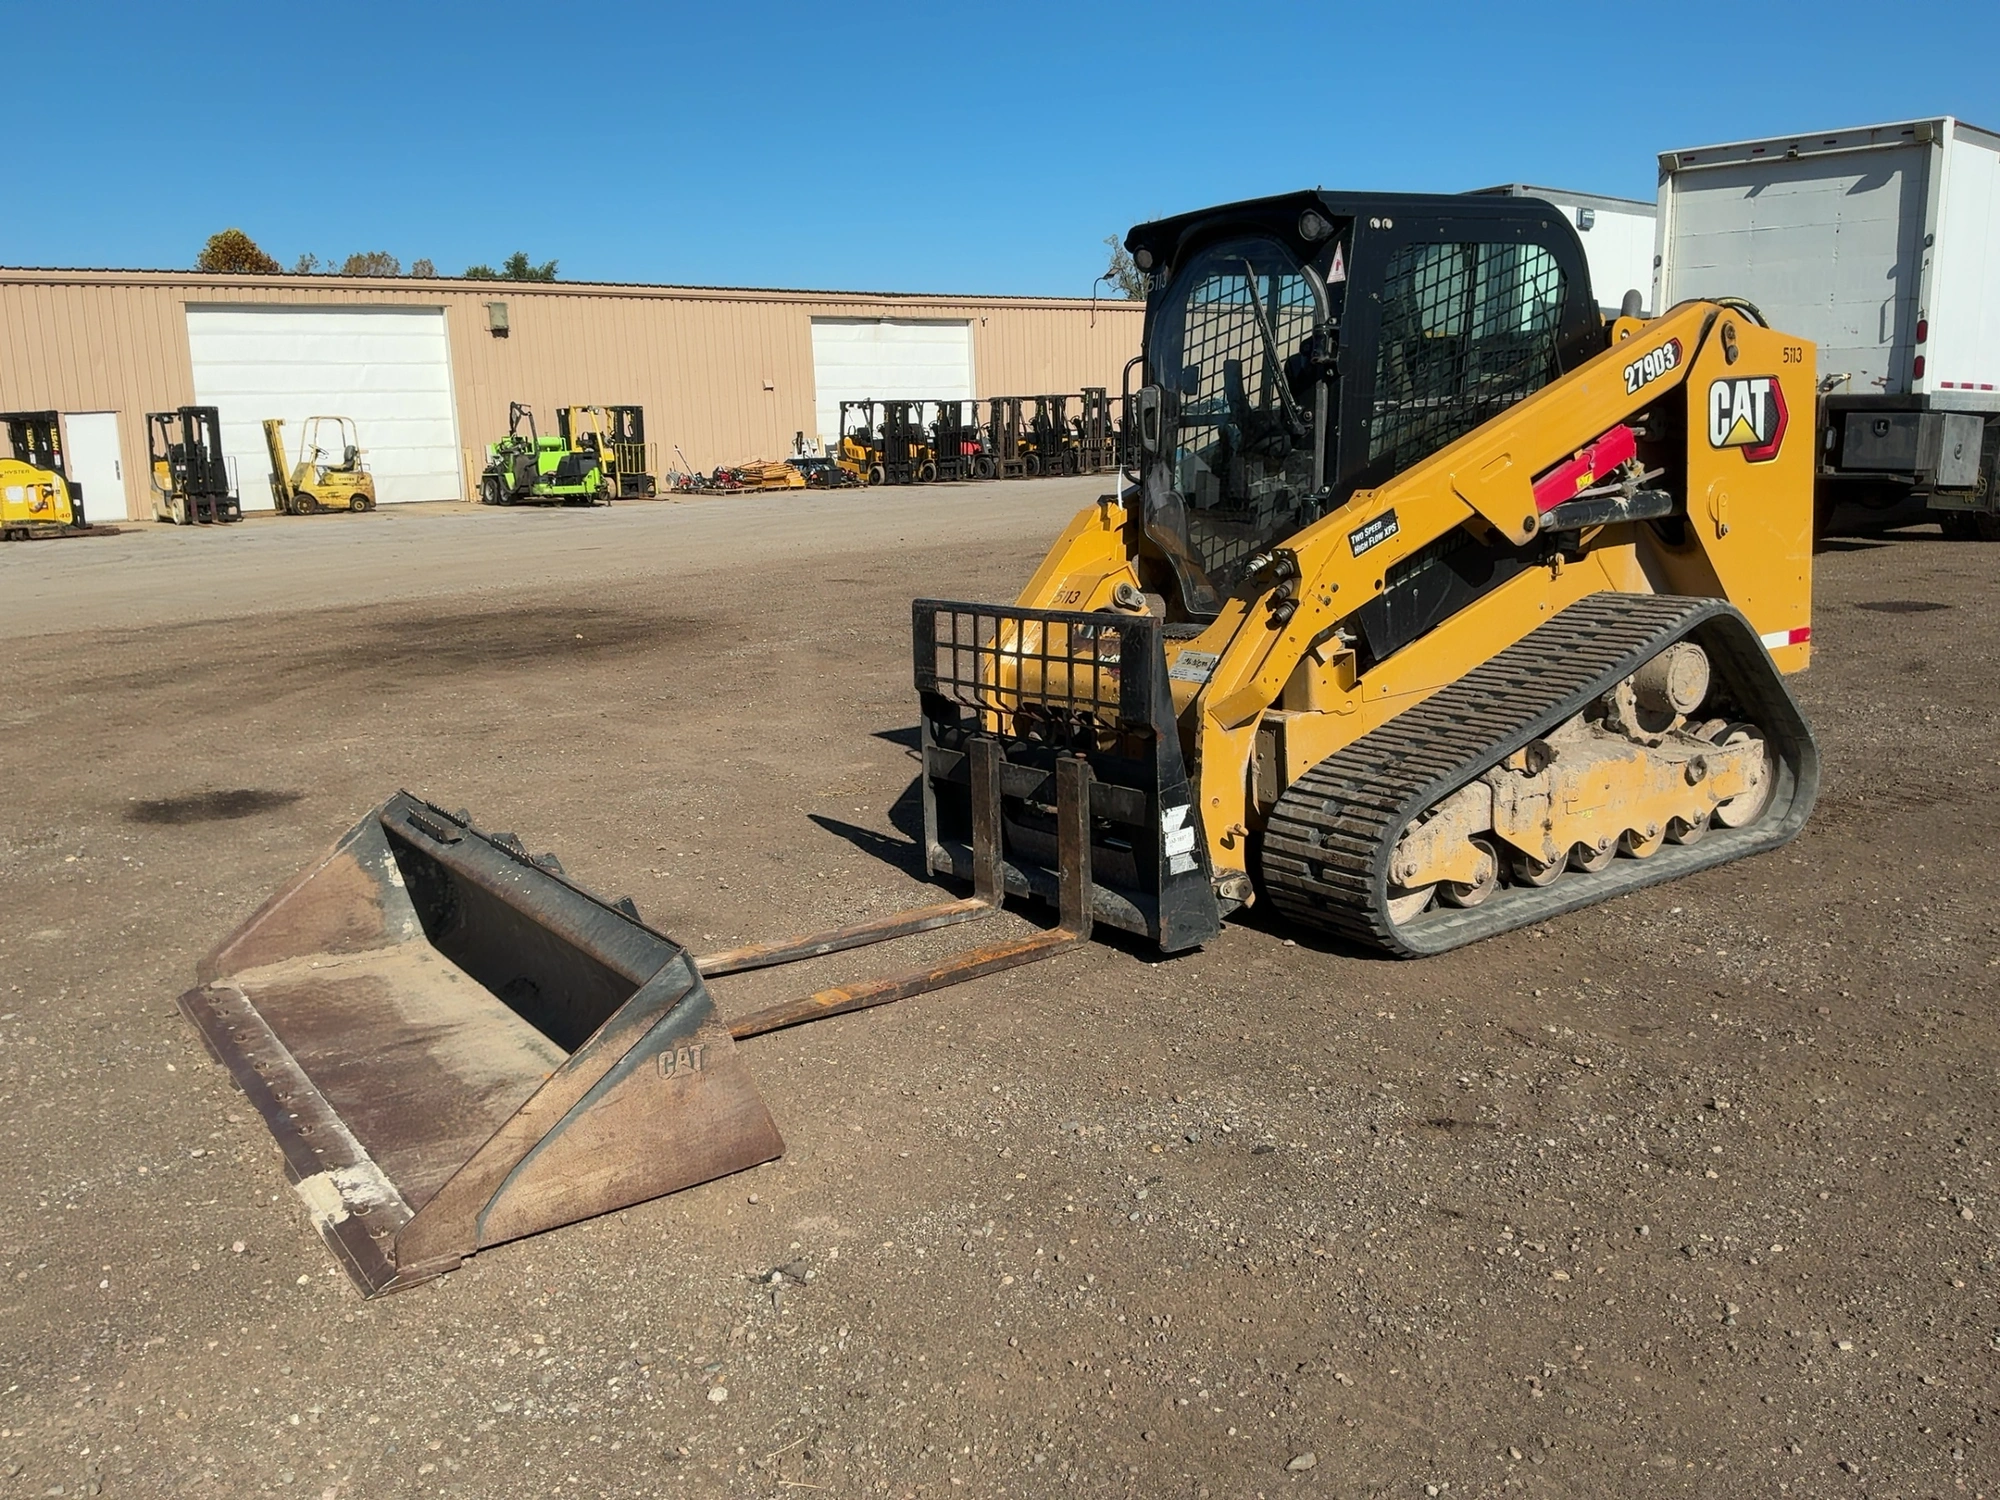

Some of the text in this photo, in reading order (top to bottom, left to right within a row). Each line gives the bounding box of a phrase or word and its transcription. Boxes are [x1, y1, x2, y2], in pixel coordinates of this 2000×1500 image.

[1782, 347, 1803, 364] 5113
[1624, 343, 1676, 396] 279D3
[1709, 379, 1770, 447] CAT
[1384, 522, 1397, 537] XPS
[1052, 590, 1081, 604] 5113
[657, 1044, 705, 1081] CAT
